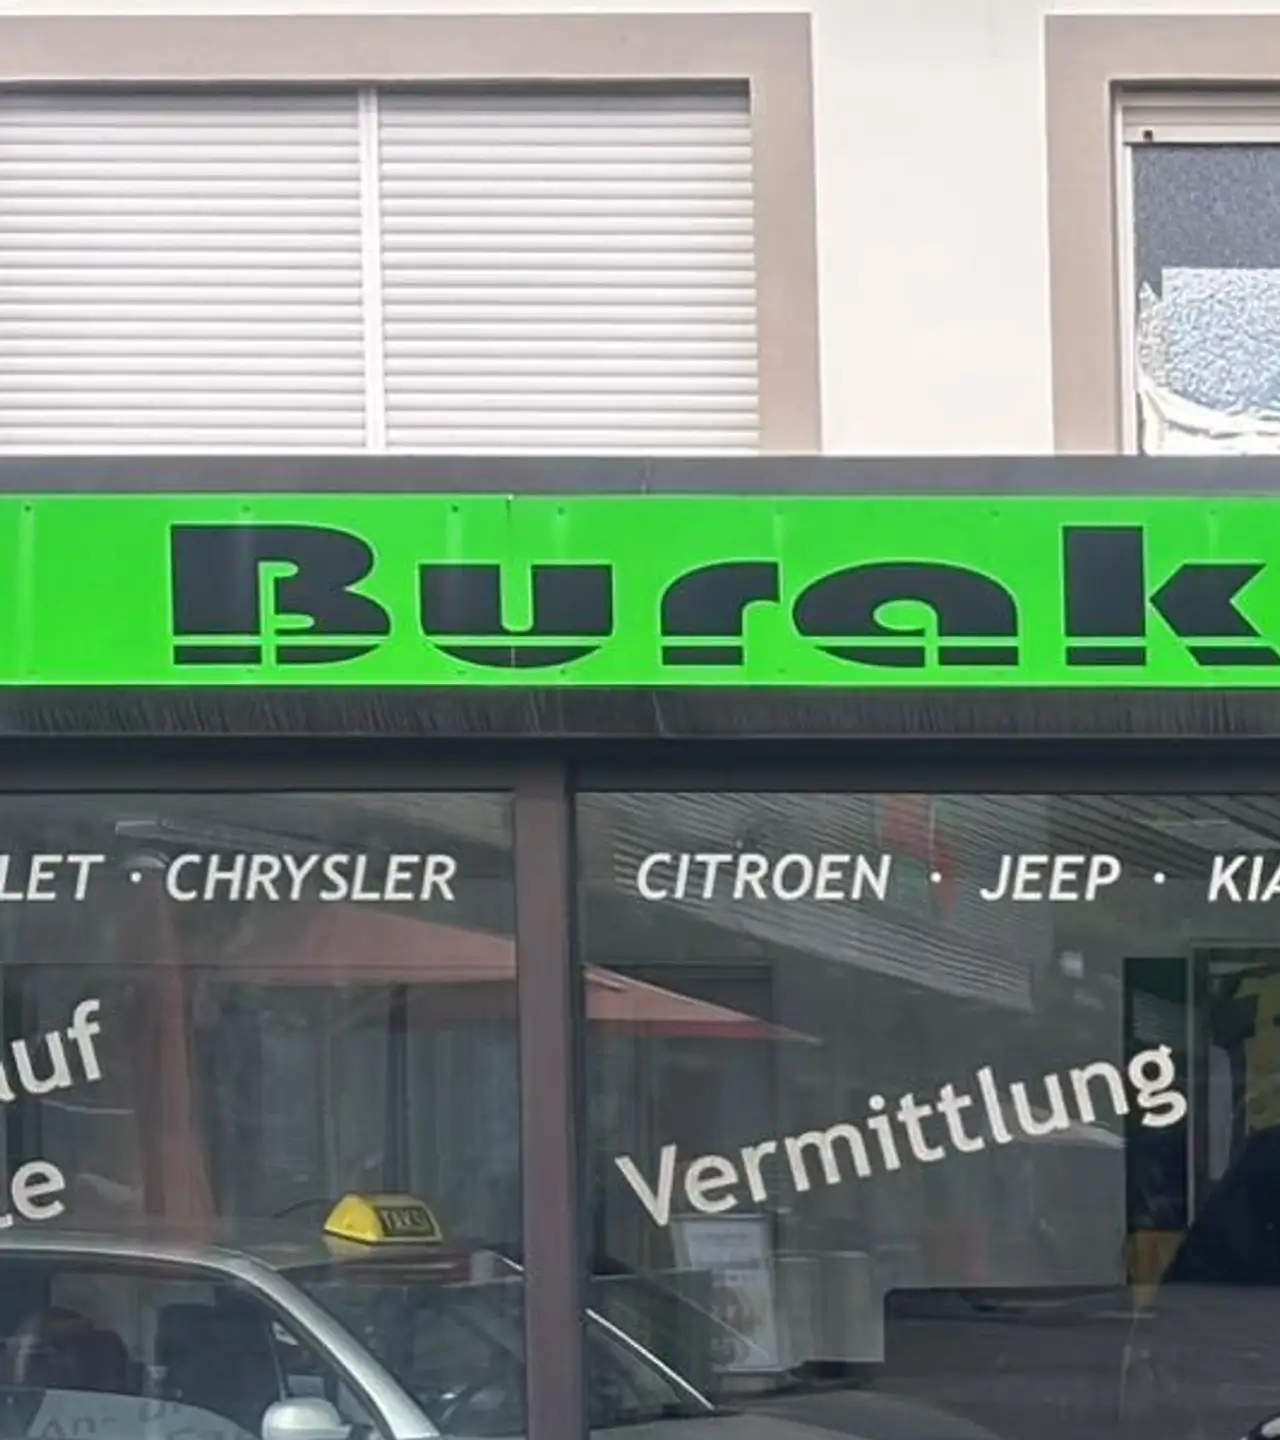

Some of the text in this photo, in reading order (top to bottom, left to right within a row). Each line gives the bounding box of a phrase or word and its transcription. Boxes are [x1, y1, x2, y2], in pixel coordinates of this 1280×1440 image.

[166, 853, 457, 902] CHRYSLER
[636, 851, 892, 902] CITROEN
[979, 853, 1122, 902] JEEP
[0, 998, 102, 1101] uf
[614, 1043, 1188, 1227] Vermittlung
[0, 1160, 66, 1229] e
